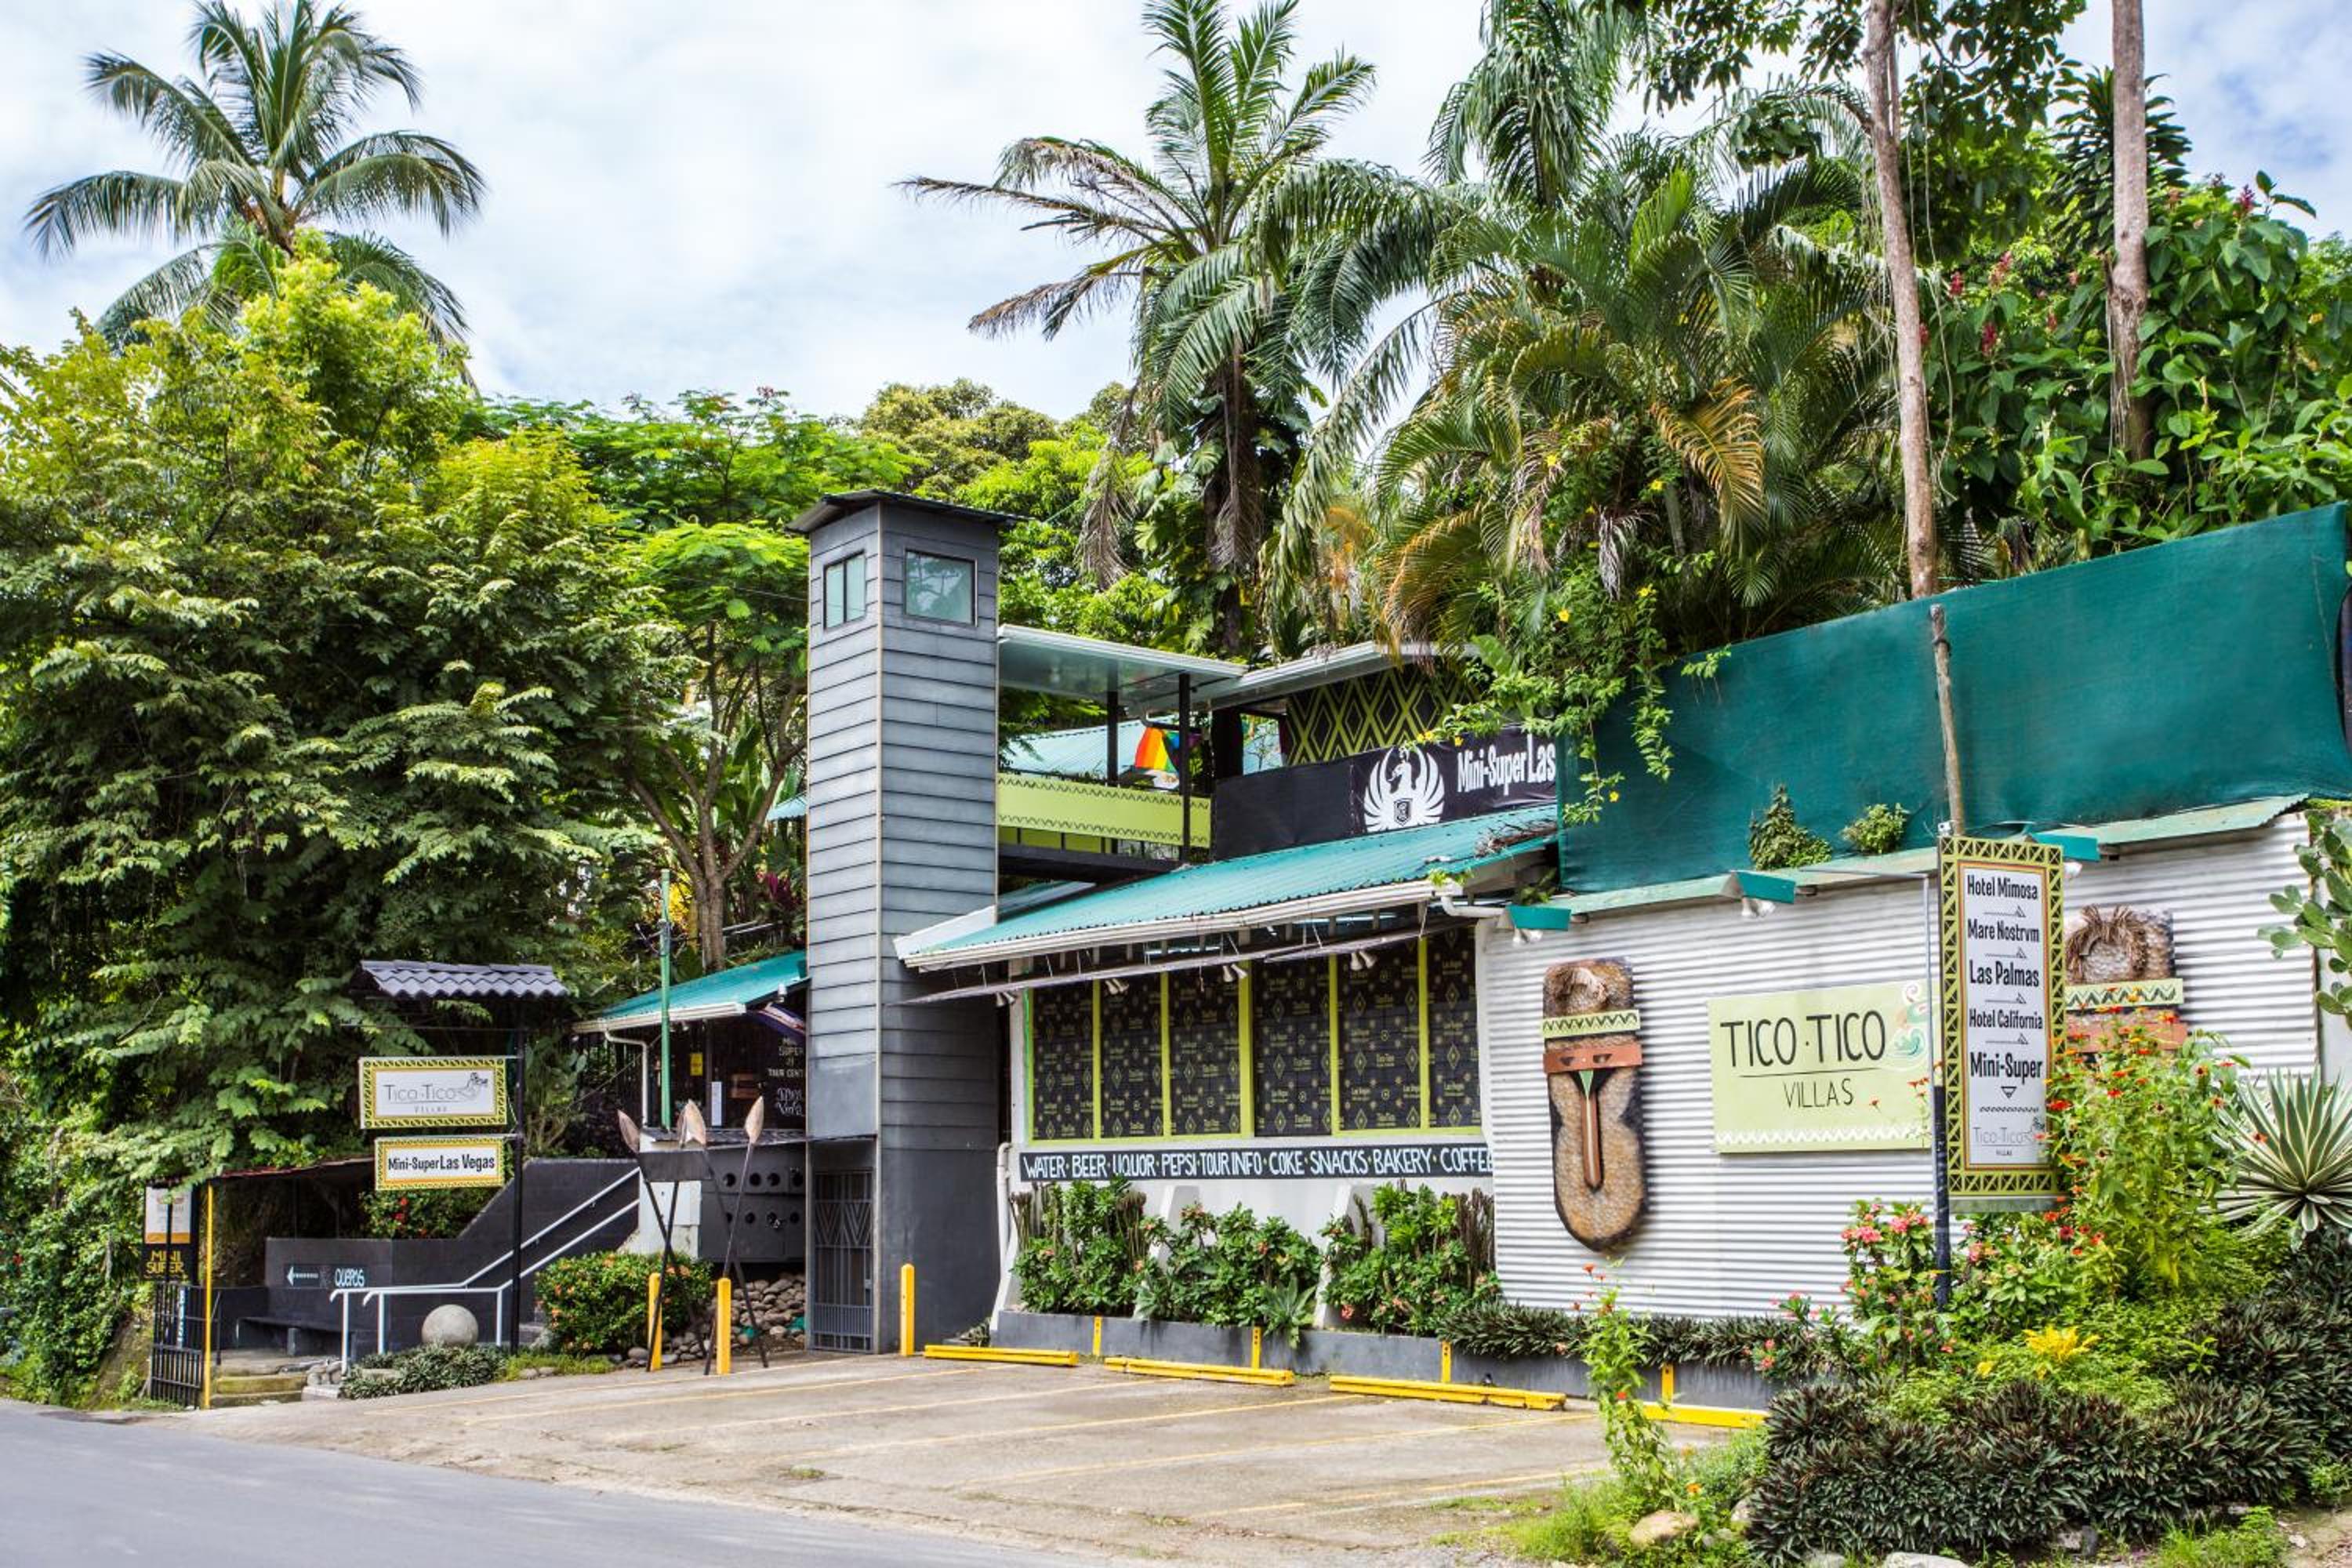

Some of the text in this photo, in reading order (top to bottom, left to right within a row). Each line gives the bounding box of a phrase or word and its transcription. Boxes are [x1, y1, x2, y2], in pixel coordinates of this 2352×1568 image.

[1457, 733, 1556, 797] Mini-Super Las
[1967, 874, 2038, 900] Hotel Mimosa
[1967, 918, 1995, 939] Mare
[1969, 959, 2039, 987] Las Palmas
[1969, 1008, 2043, 1029] Hotel California
[1720, 1011, 1886, 1067] TICO TICO
[1970, 1051, 2043, 1085] Mini-Super
[1783, 1078, 1854, 1108] VILLAS
[388, 1153, 495, 1172] Mini-Super Las Vegas
[1023, 1155, 1065, 1178] WATER
[1072, 1154, 1107, 1178] BEER
[1161, 1152, 1196, 1176] PEPSI
[1199, 1152, 1230, 1175] TOUR
[1231, 1151, 1262, 1175] INFO
[1269, 1151, 1305, 1175] COKE
[1310, 1150, 1367, 1175] SNACKS
[1374, 1148, 1432, 1174] BAKERY
